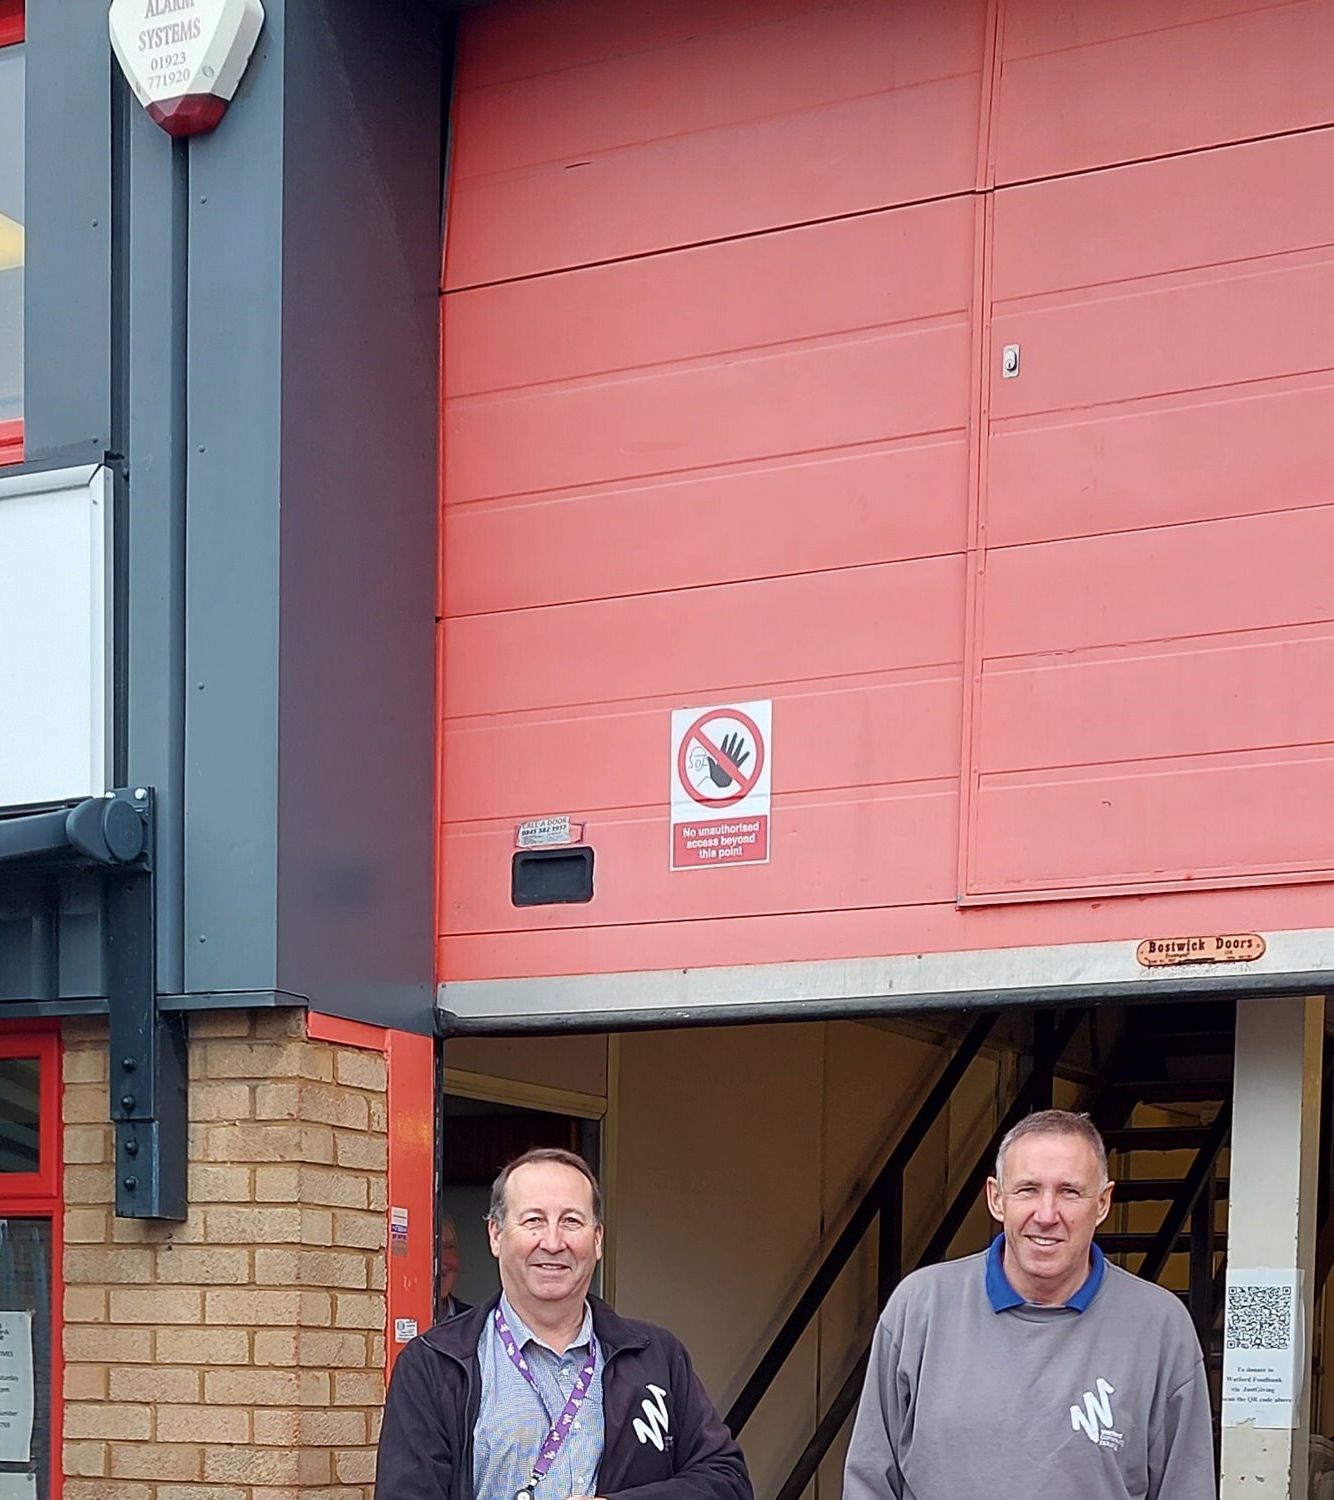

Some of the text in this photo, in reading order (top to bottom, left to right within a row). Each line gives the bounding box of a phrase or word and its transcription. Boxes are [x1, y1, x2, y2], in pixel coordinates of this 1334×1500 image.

[138, 18, 201, 52] SYSTEMS
[150, 51, 187, 72] 01923
[148, 68, 191, 90] 771920
[683, 821, 760, 838] No unauthorised
[686, 833, 756, 849] access beyond
[699, 846, 743, 860] this point
[1149, 937, 1253, 953] Bostwick Doors
